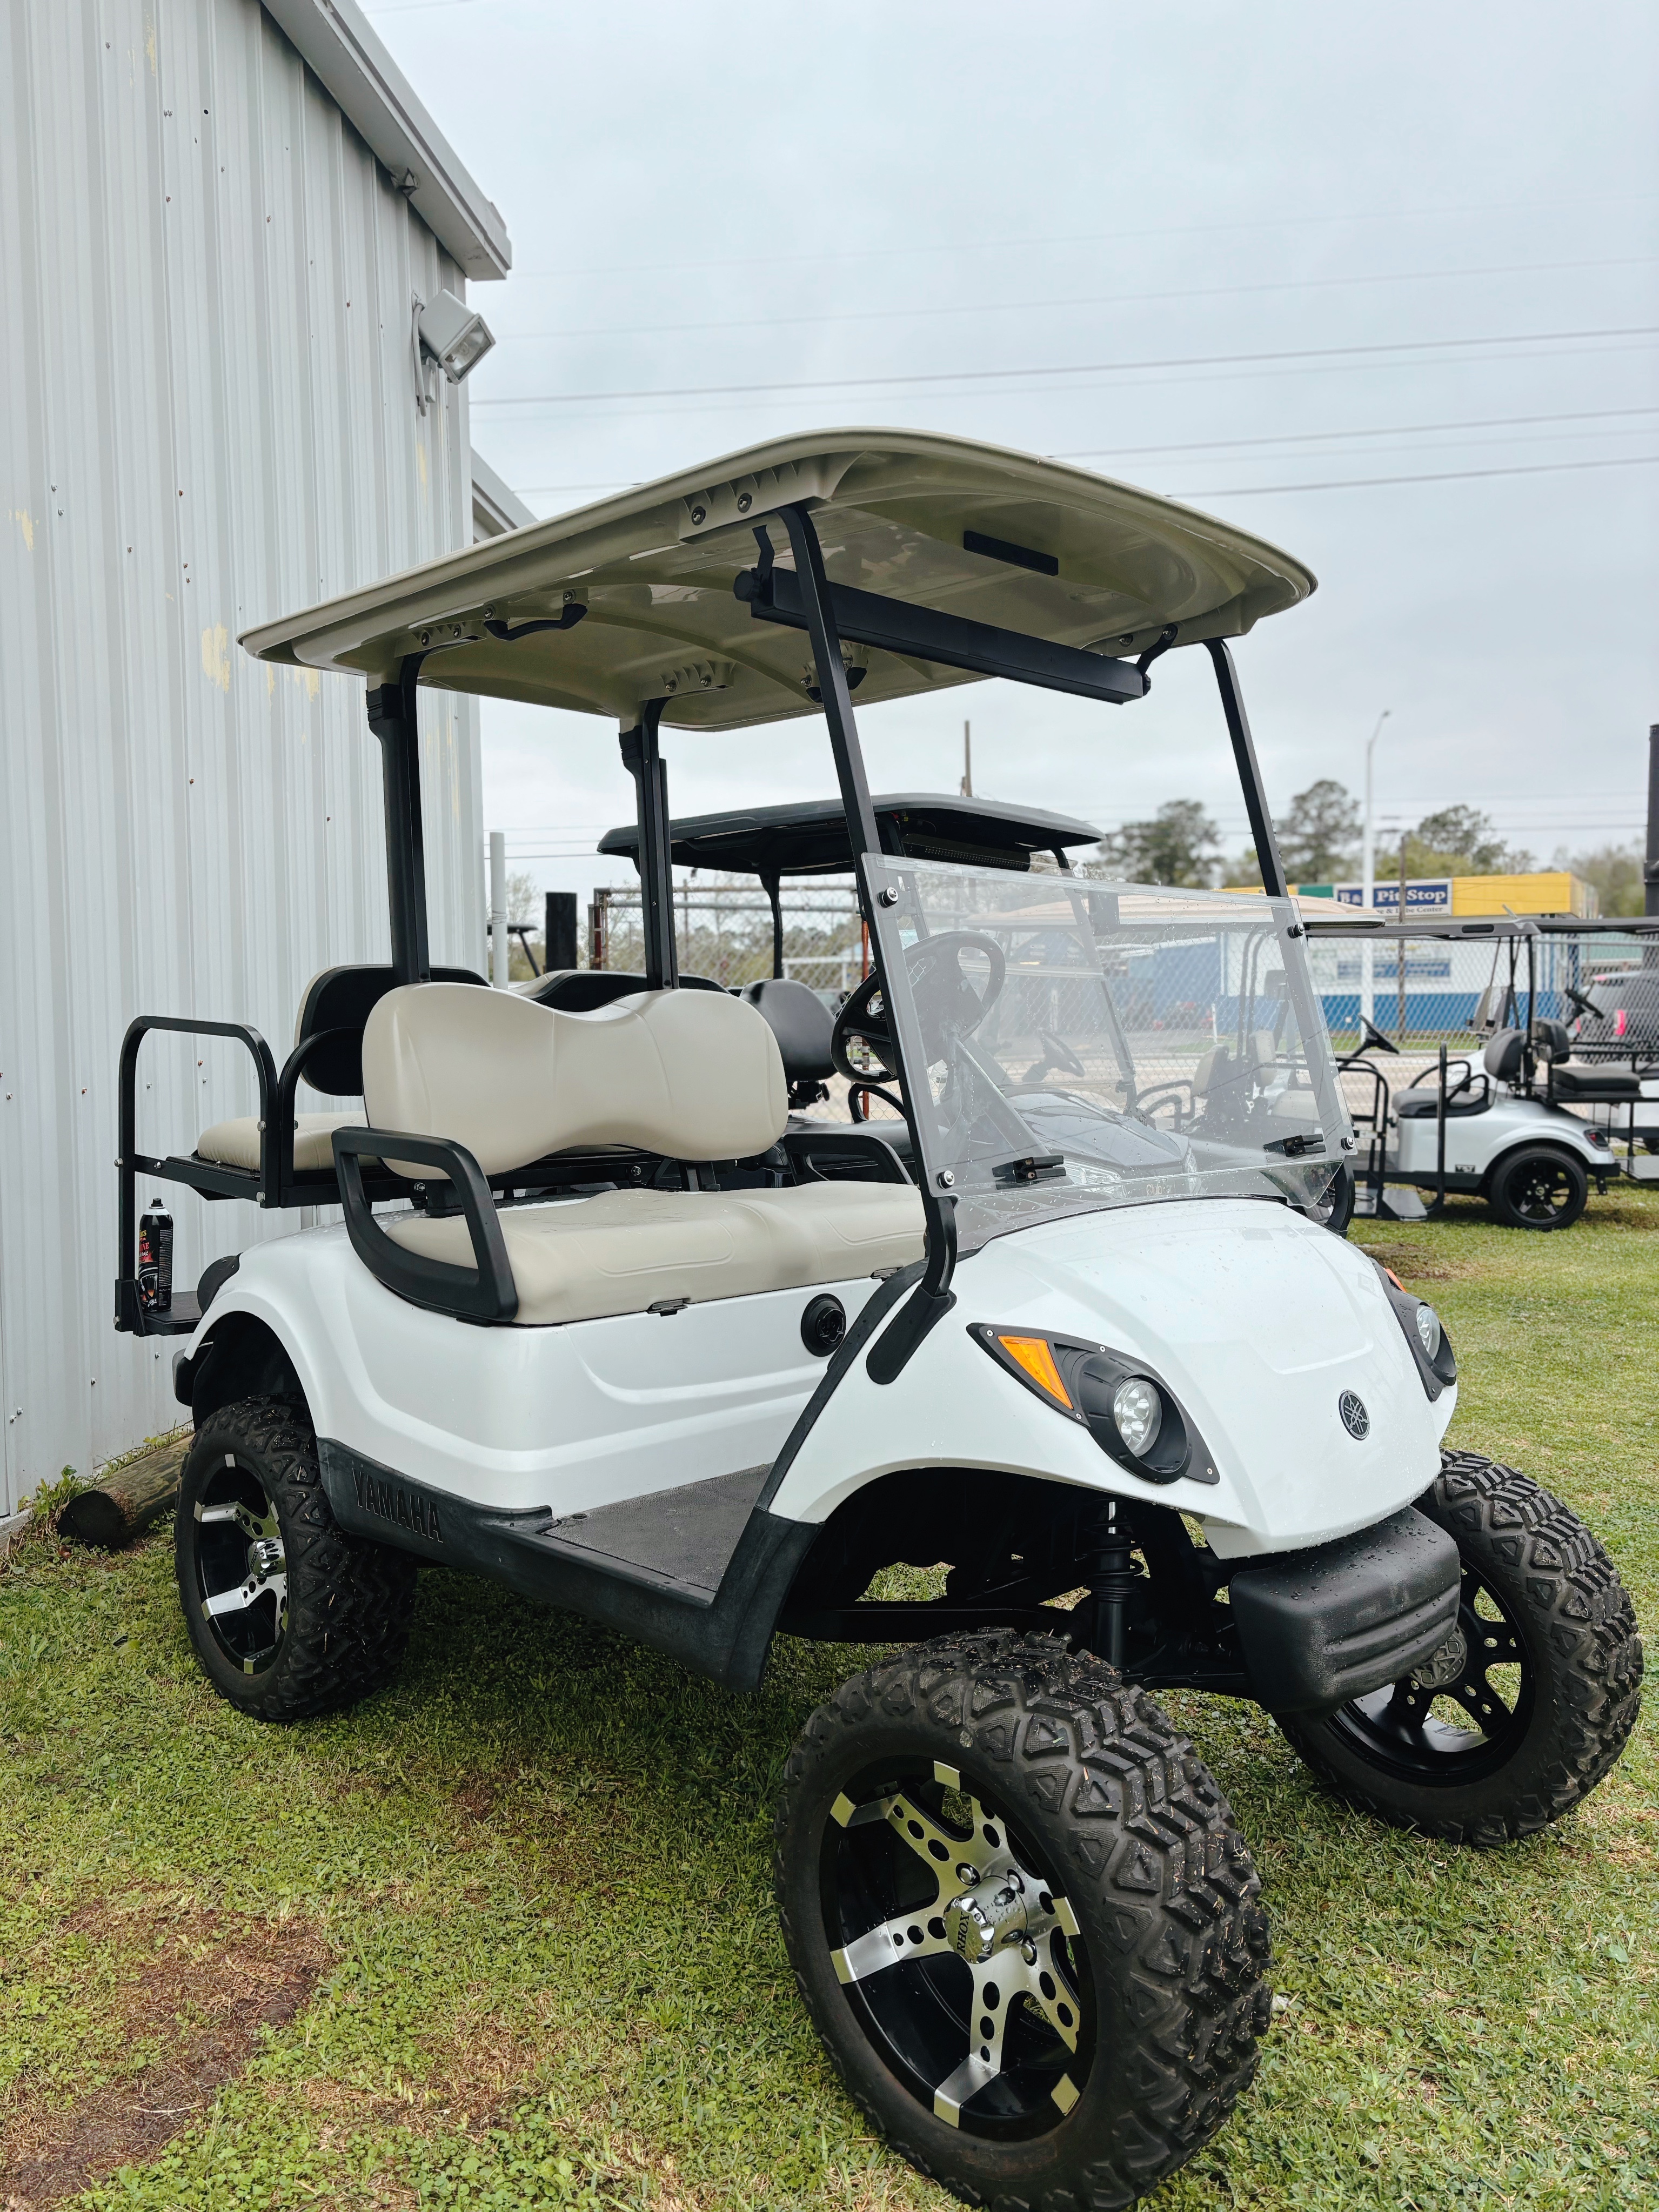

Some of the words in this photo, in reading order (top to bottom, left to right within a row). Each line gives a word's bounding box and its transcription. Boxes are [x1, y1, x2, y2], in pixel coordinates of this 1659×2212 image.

[1376, 890, 1400, 902] Pit
[1407, 889, 1446, 903] Stop
[352, 1466, 444, 1543] YAMAHA
[956, 1911, 970, 1955] RHOX
